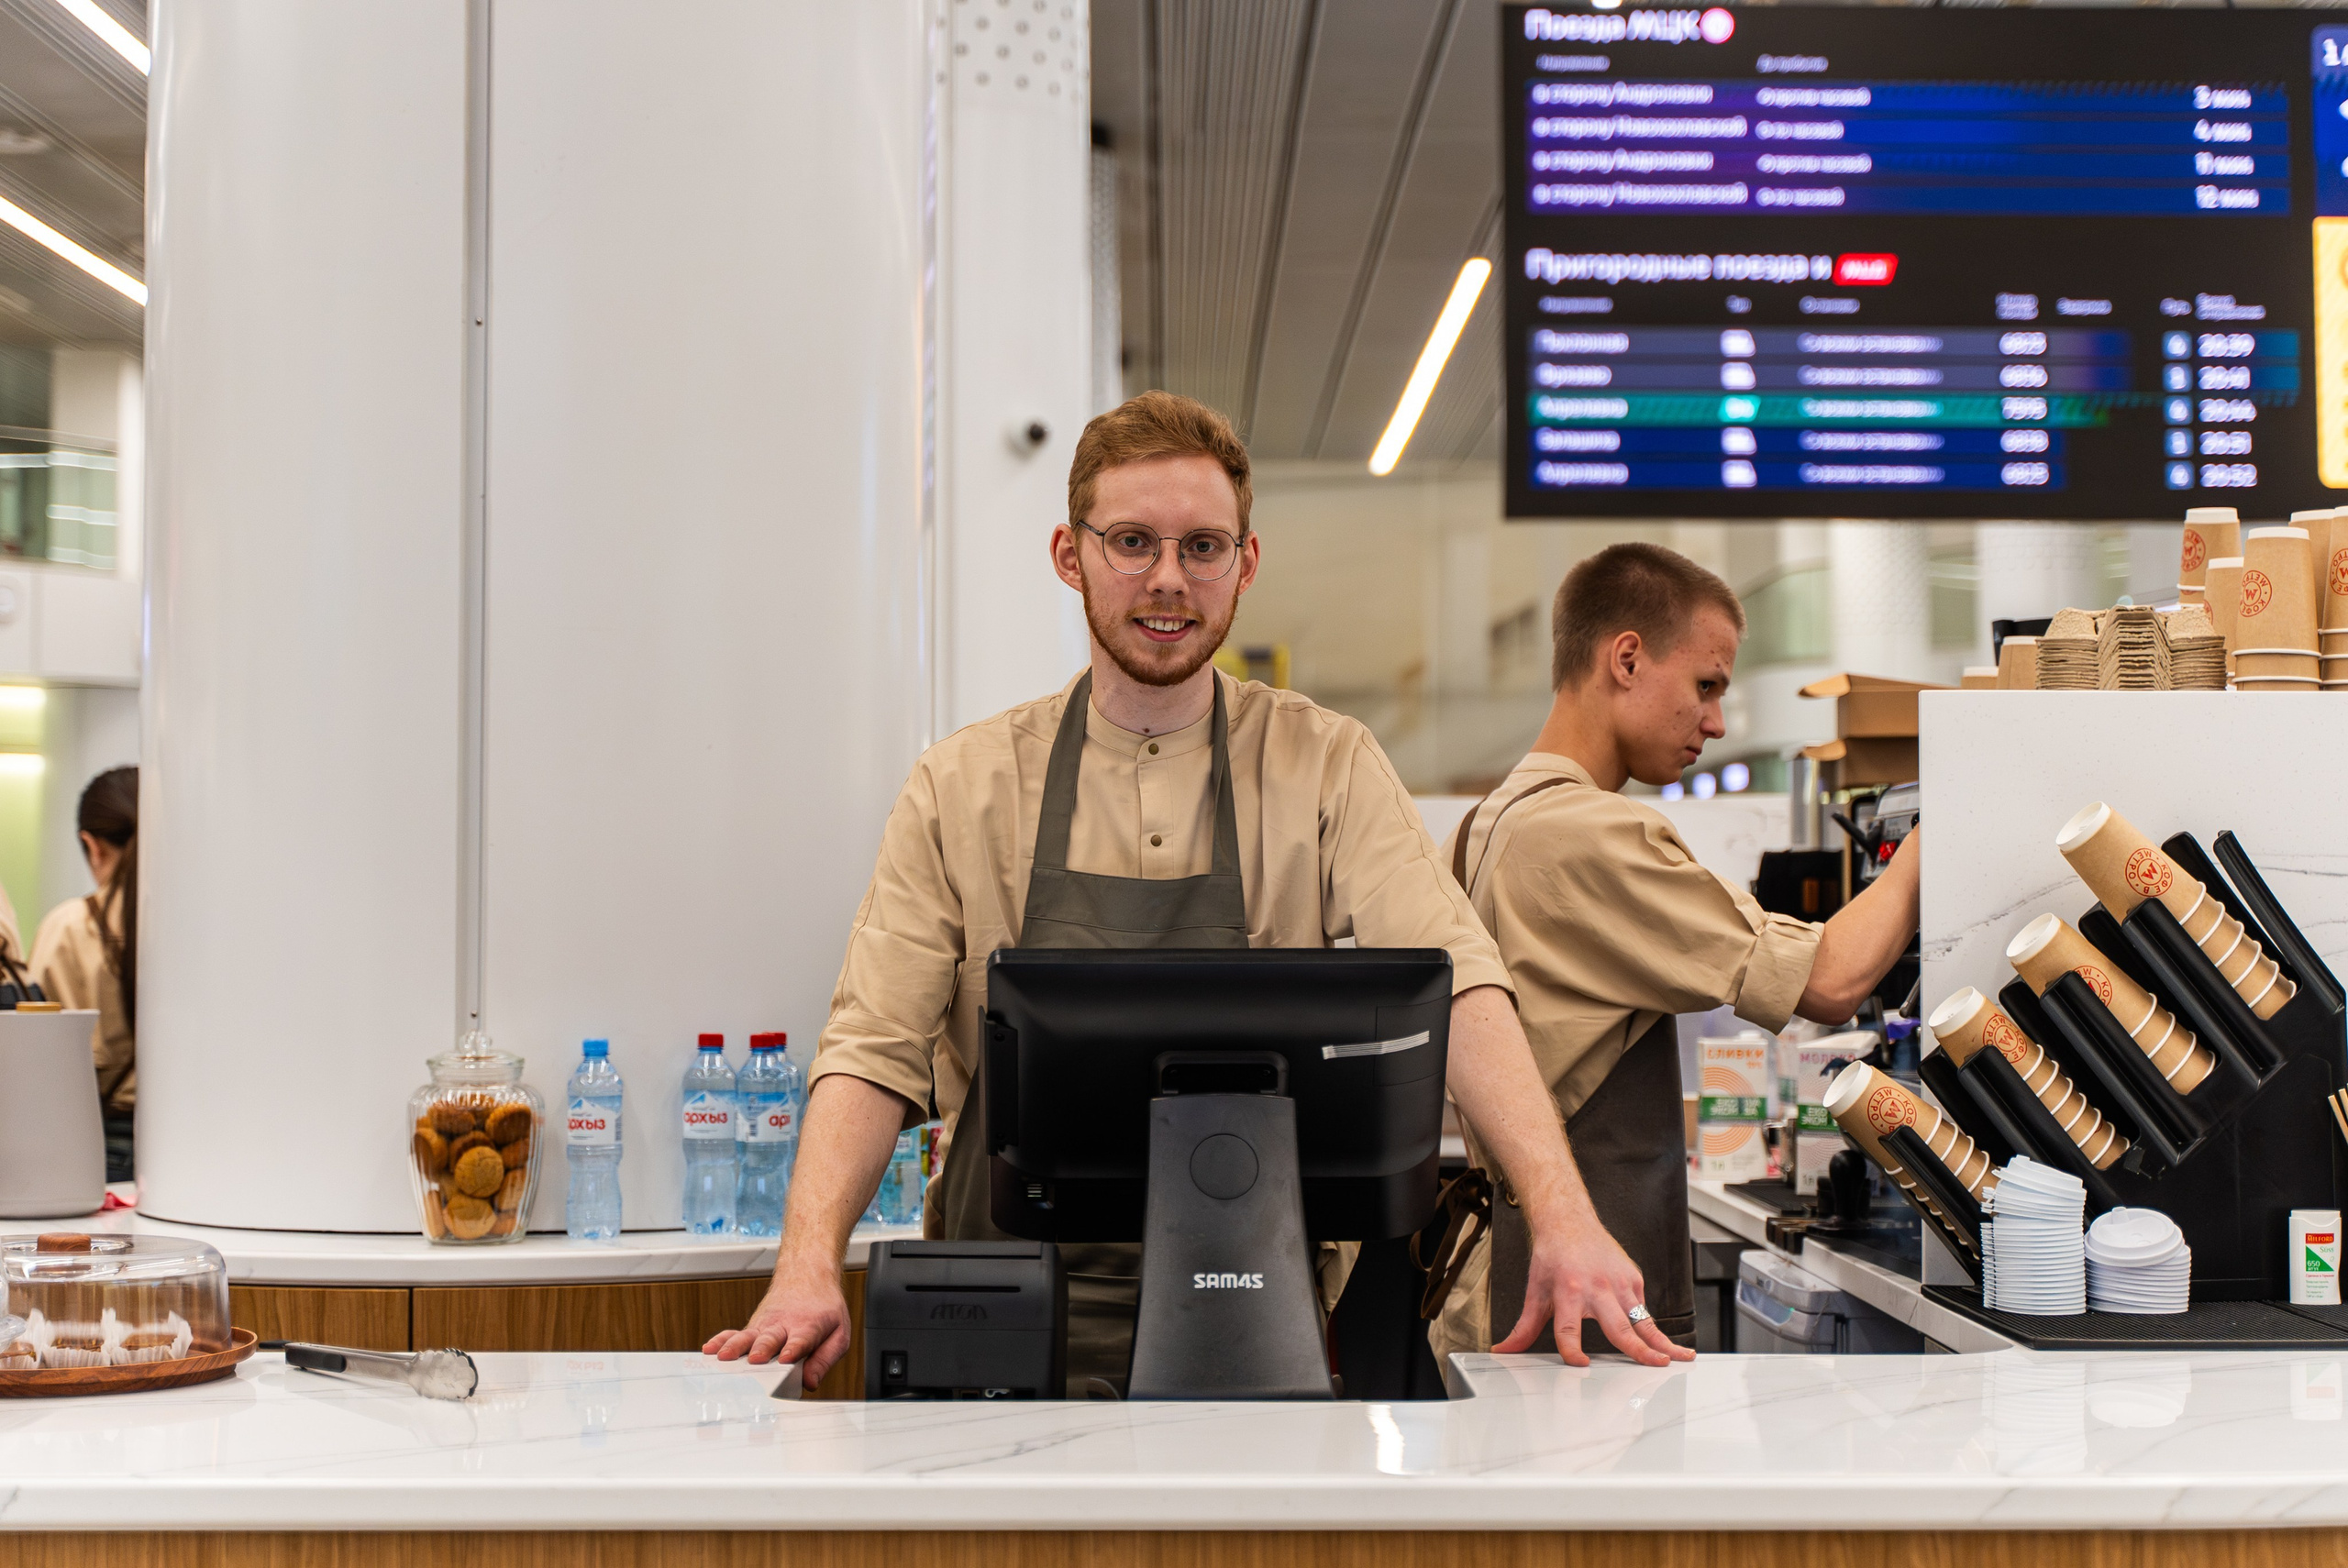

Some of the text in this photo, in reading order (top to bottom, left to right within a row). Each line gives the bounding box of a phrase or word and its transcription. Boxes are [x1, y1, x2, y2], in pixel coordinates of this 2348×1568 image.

[1526, 248, 1712, 283] Пригородные
[1713, 254, 1809, 283] поезда
[2128, 850, 2152, 879] МЕТРО
[2154, 864, 2171, 894] КОФЕ
[1707, 1048, 1765, 1060] СЛИВКИ
[1870, 1089, 1892, 1121] МЕТРО
[1899, 1099, 1914, 1126] КОФ
[1193, 1273, 1264, 1289] SAM4S
